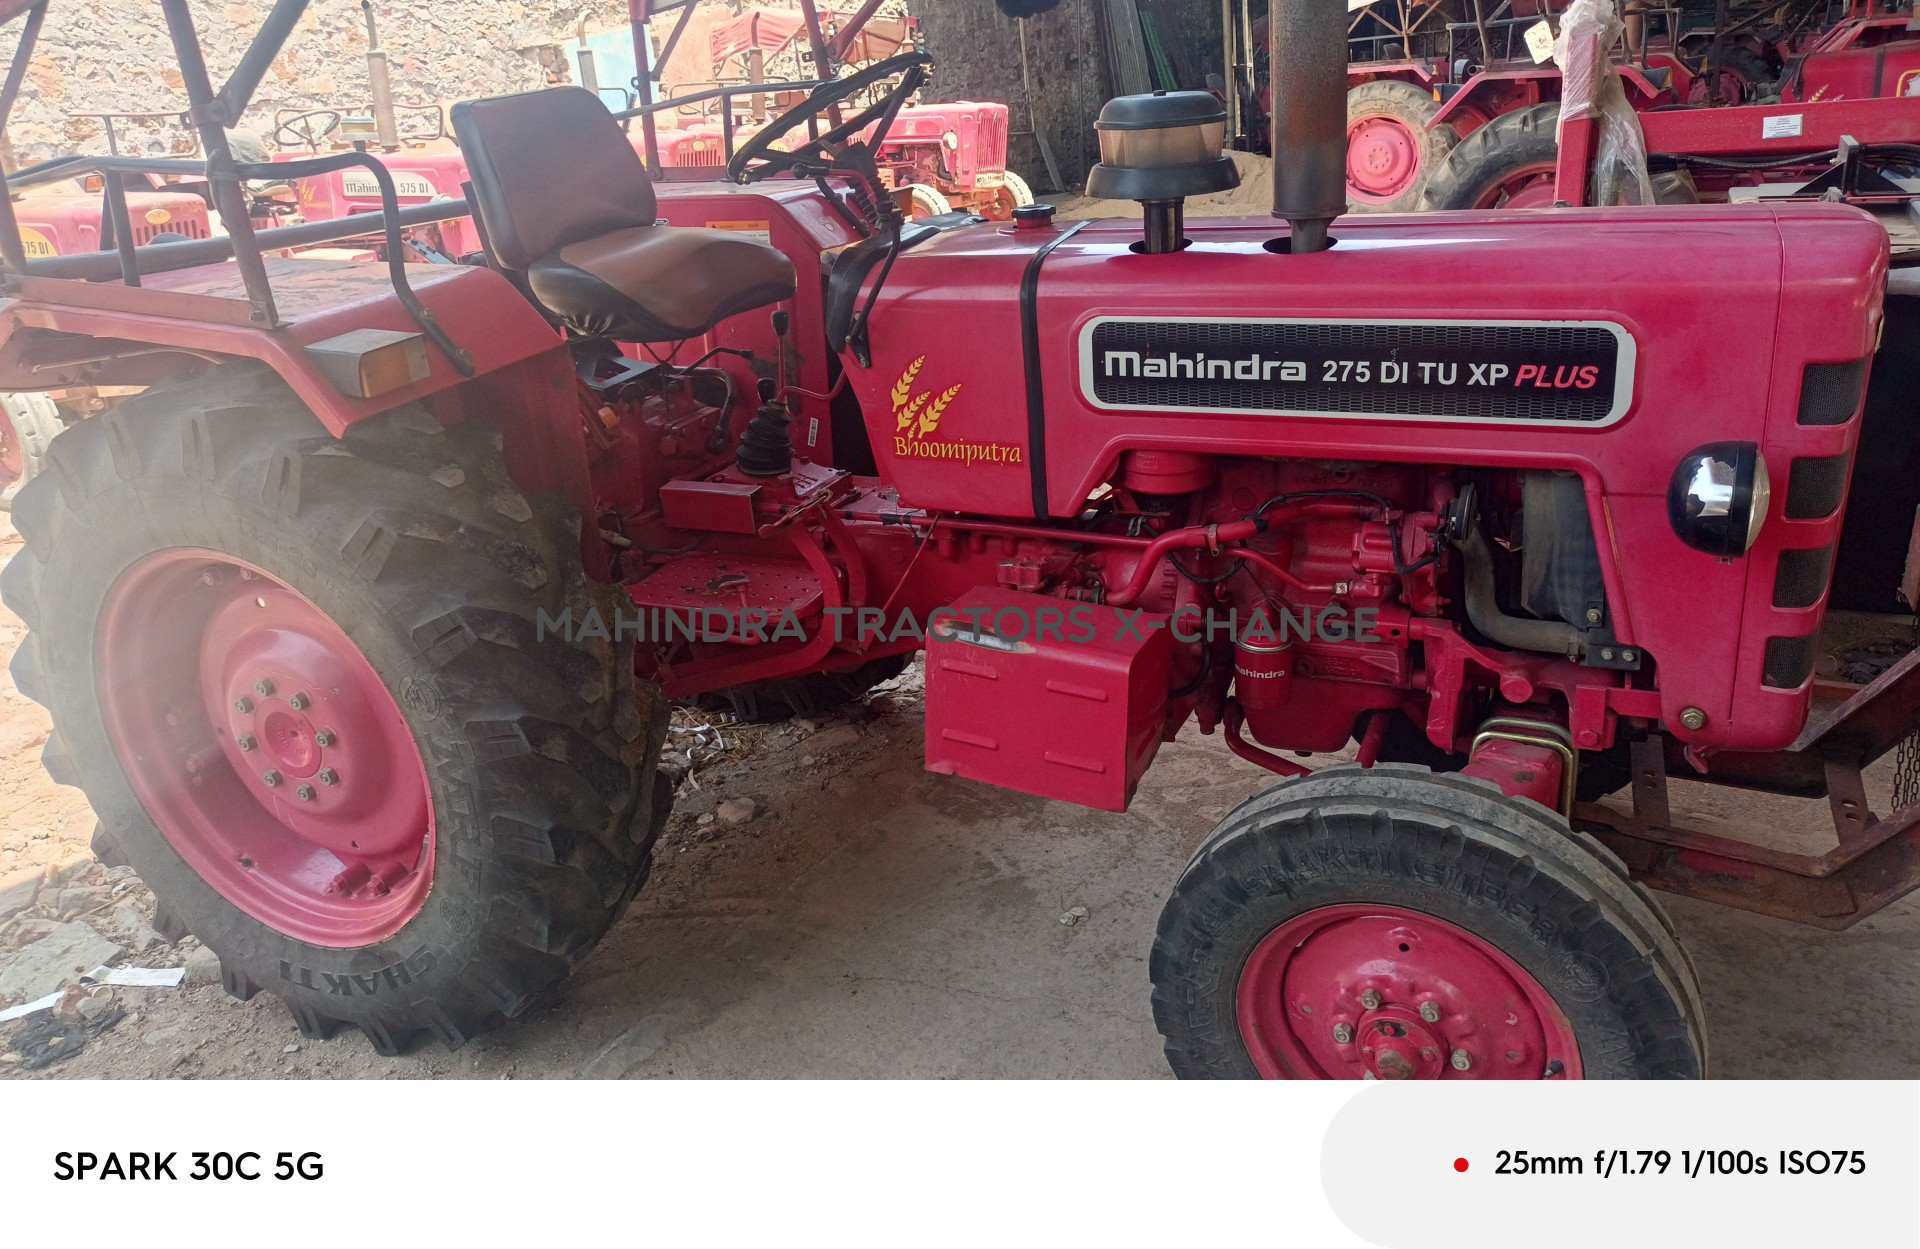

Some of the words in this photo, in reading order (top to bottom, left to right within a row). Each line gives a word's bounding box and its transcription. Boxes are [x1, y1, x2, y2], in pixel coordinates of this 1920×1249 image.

[345, 182, 383, 193] Mahin
[400, 182, 416, 194] 575
[419, 182, 429, 194] DI
[37, 241, 49, 254] DI
[1322, 360, 1371, 383] 275
[1380, 361, 1408, 384] DI
[1418, 362, 1457, 385] TU
[1468, 363, 1509, 386] XP
[1514, 364, 1599, 389] PLUS
[893, 436, 1022, 467] Bhoomiputra
[1240, 847, 1393, 895] SHAKTI
[1414, 853, 1558, 948] SUPER
[279, 943, 439, 997] SHAKTI
